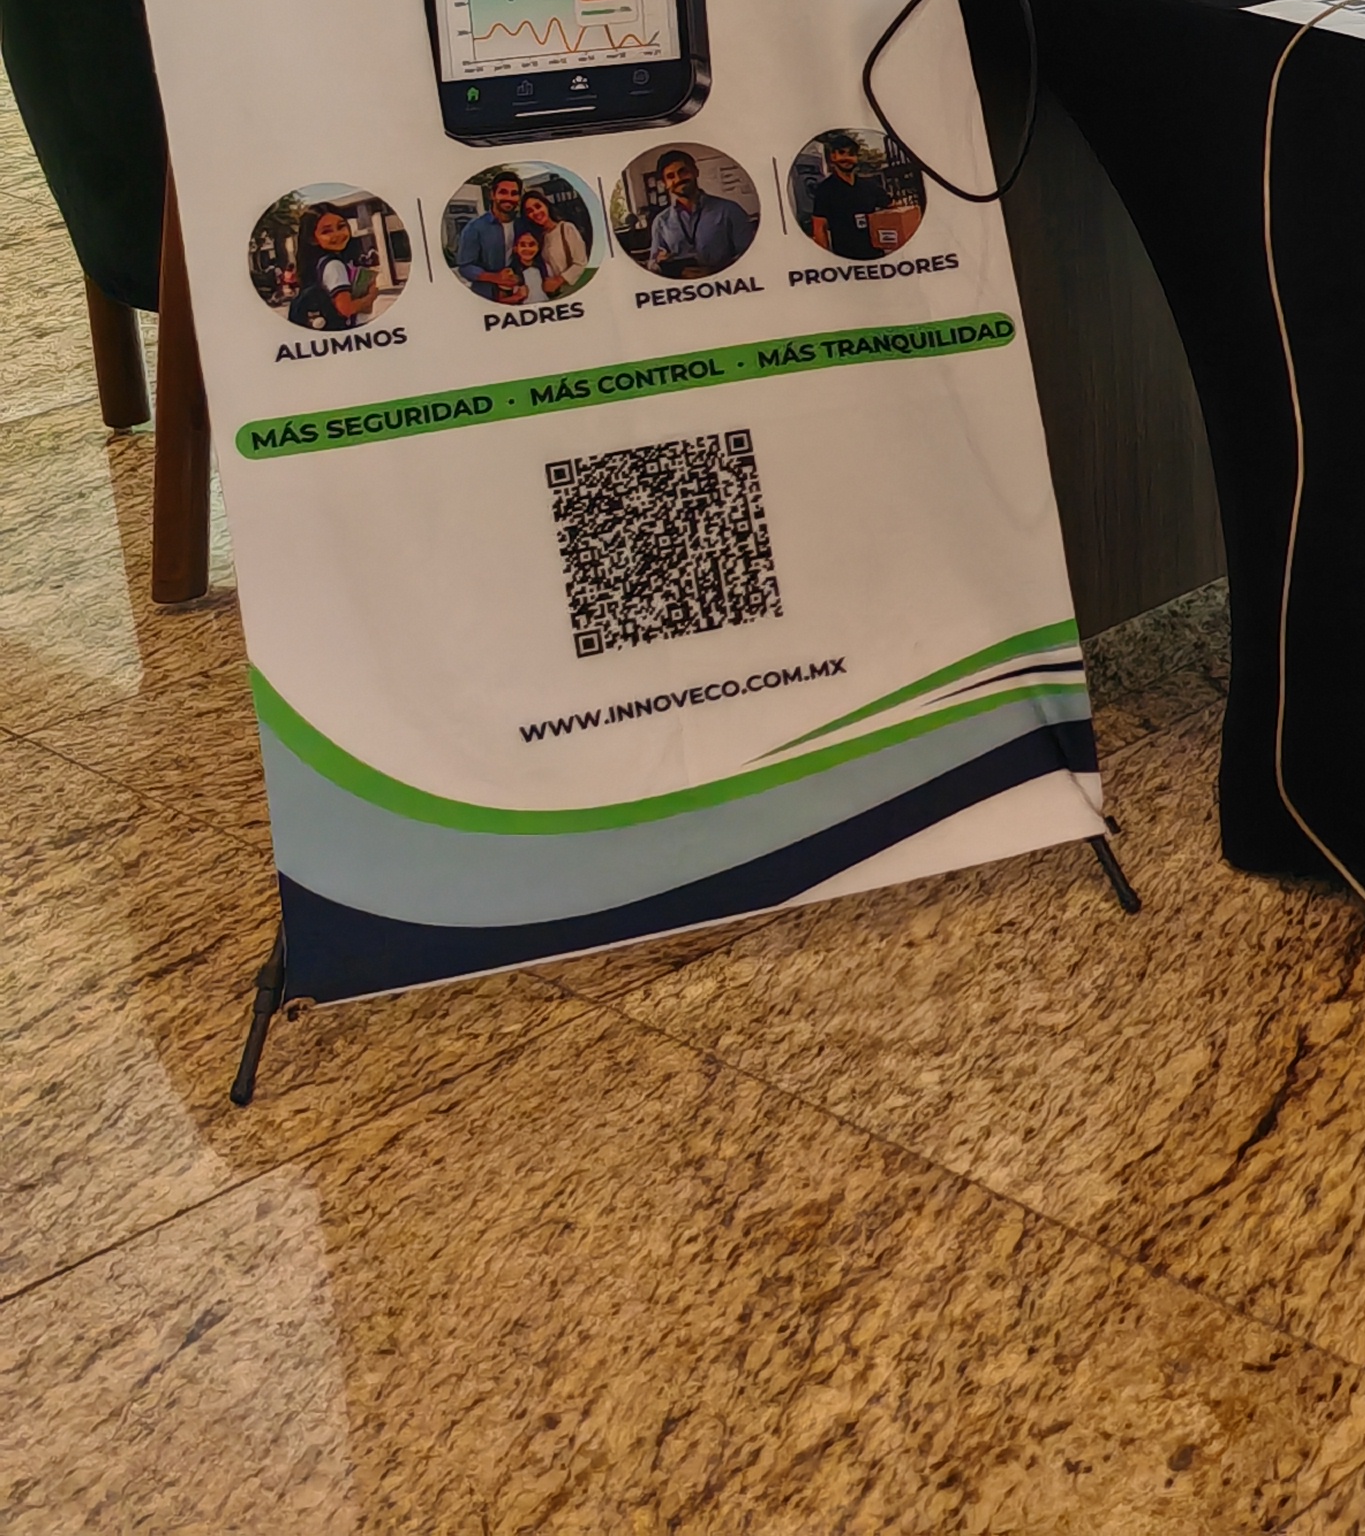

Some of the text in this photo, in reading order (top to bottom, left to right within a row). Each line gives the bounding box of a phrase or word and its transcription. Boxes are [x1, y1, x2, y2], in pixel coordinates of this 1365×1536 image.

[788, 252, 960, 287] PROVEEDORES
[635, 276, 765, 309] PERSONAL
[483, 301, 585, 332] PADRES
[274, 327, 408, 362] ALUMNOS
[251, 319, 1015, 451] MÁS SEGURIDAD MÁS CONTROL MÁS TRANQUILIDAD
[519, 656, 847, 744] WWW.INNOVECO.COM.MX
